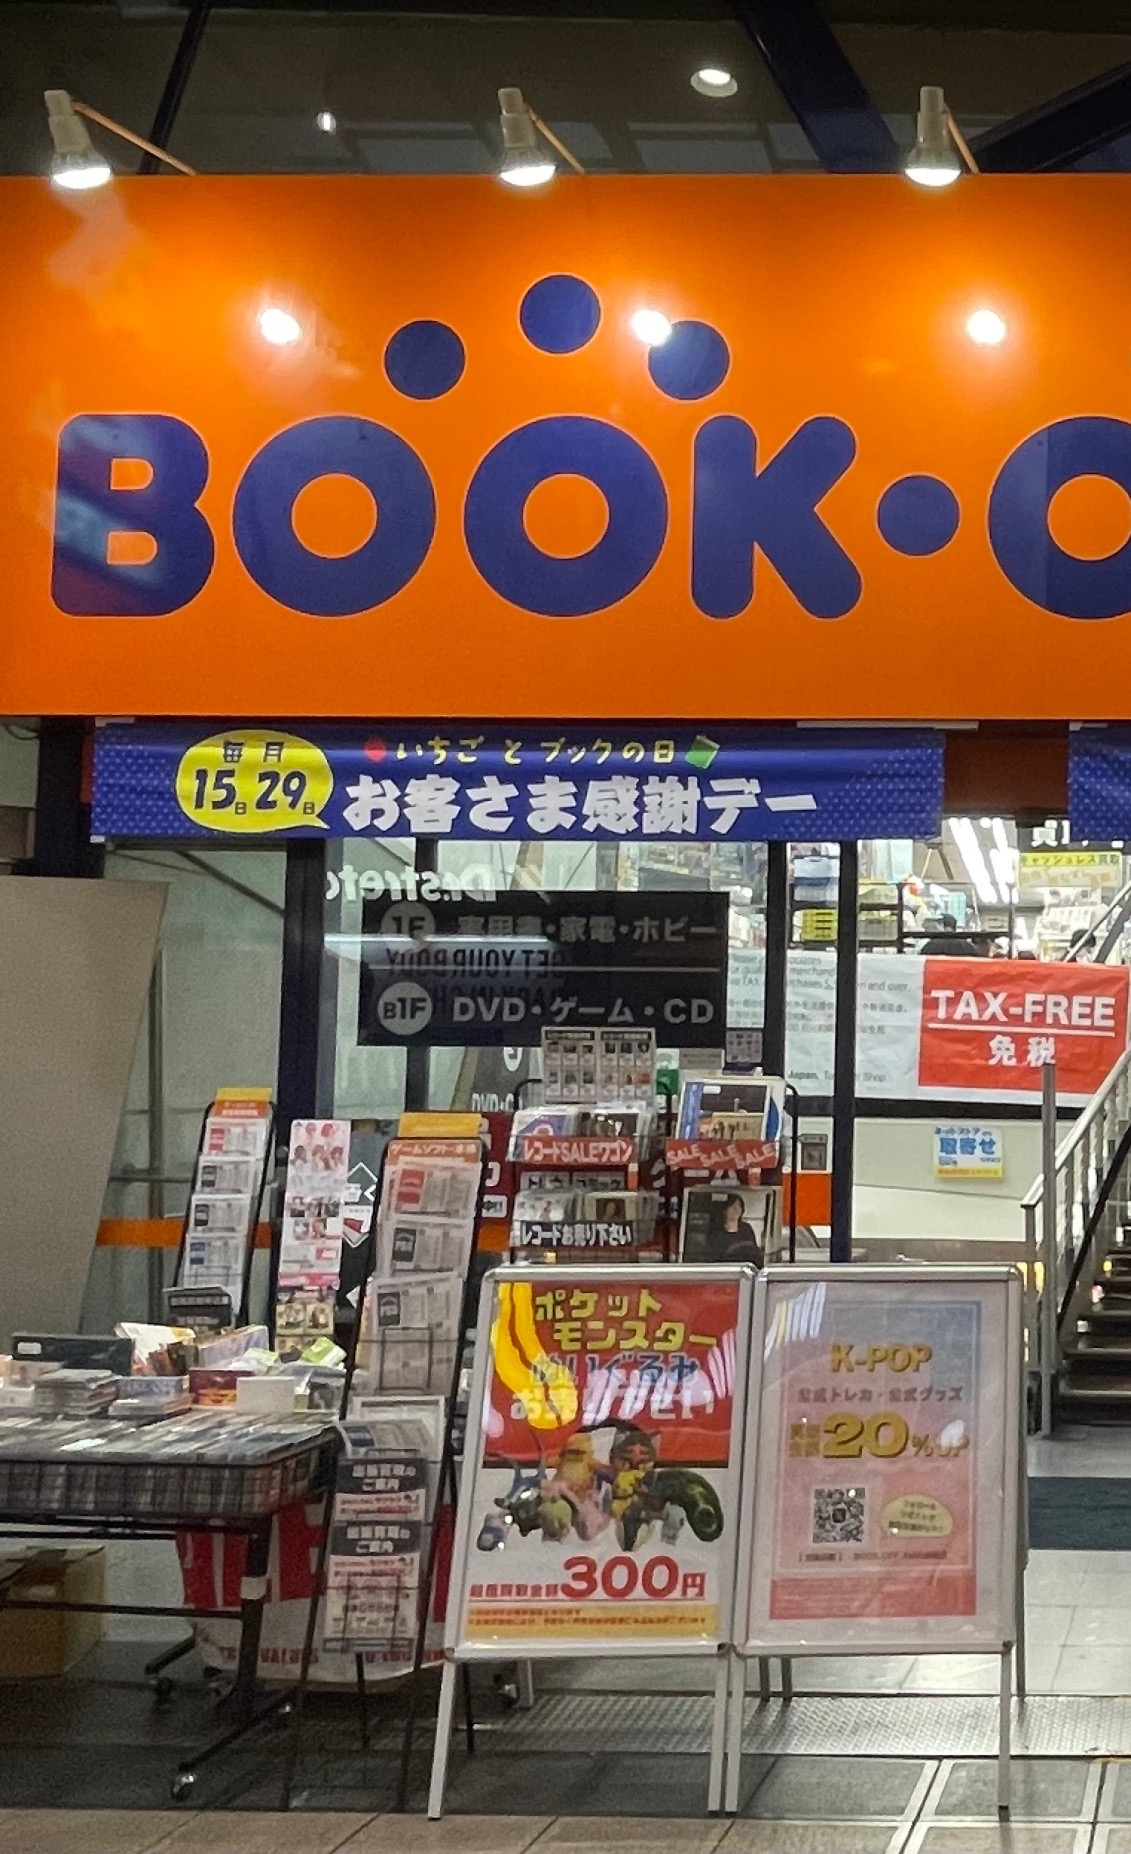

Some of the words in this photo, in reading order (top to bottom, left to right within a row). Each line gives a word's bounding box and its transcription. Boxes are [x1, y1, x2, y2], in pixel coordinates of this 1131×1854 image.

[343, 774, 818, 835] お客さま感謝デー
[930, 989, 1116, 1028] TAX-FREE
[988, 1034, 1057, 1068] 免税
[524, 1138, 633, 1163] レコードSALEワゴン
[667, 1143, 701, 1166] SALE
[700, 1143, 737, 1168] SALE
[736, 1142, 777, 1169] SALE
[522, 1222, 632, 1247] レコードお売り下さい
[535, 1288, 662, 1321] ポケット
[553, 1320, 717, 1351] モンスター
[830, 1342, 933, 1374] K-POP
[560, 1555, 707, 1599] 300円
